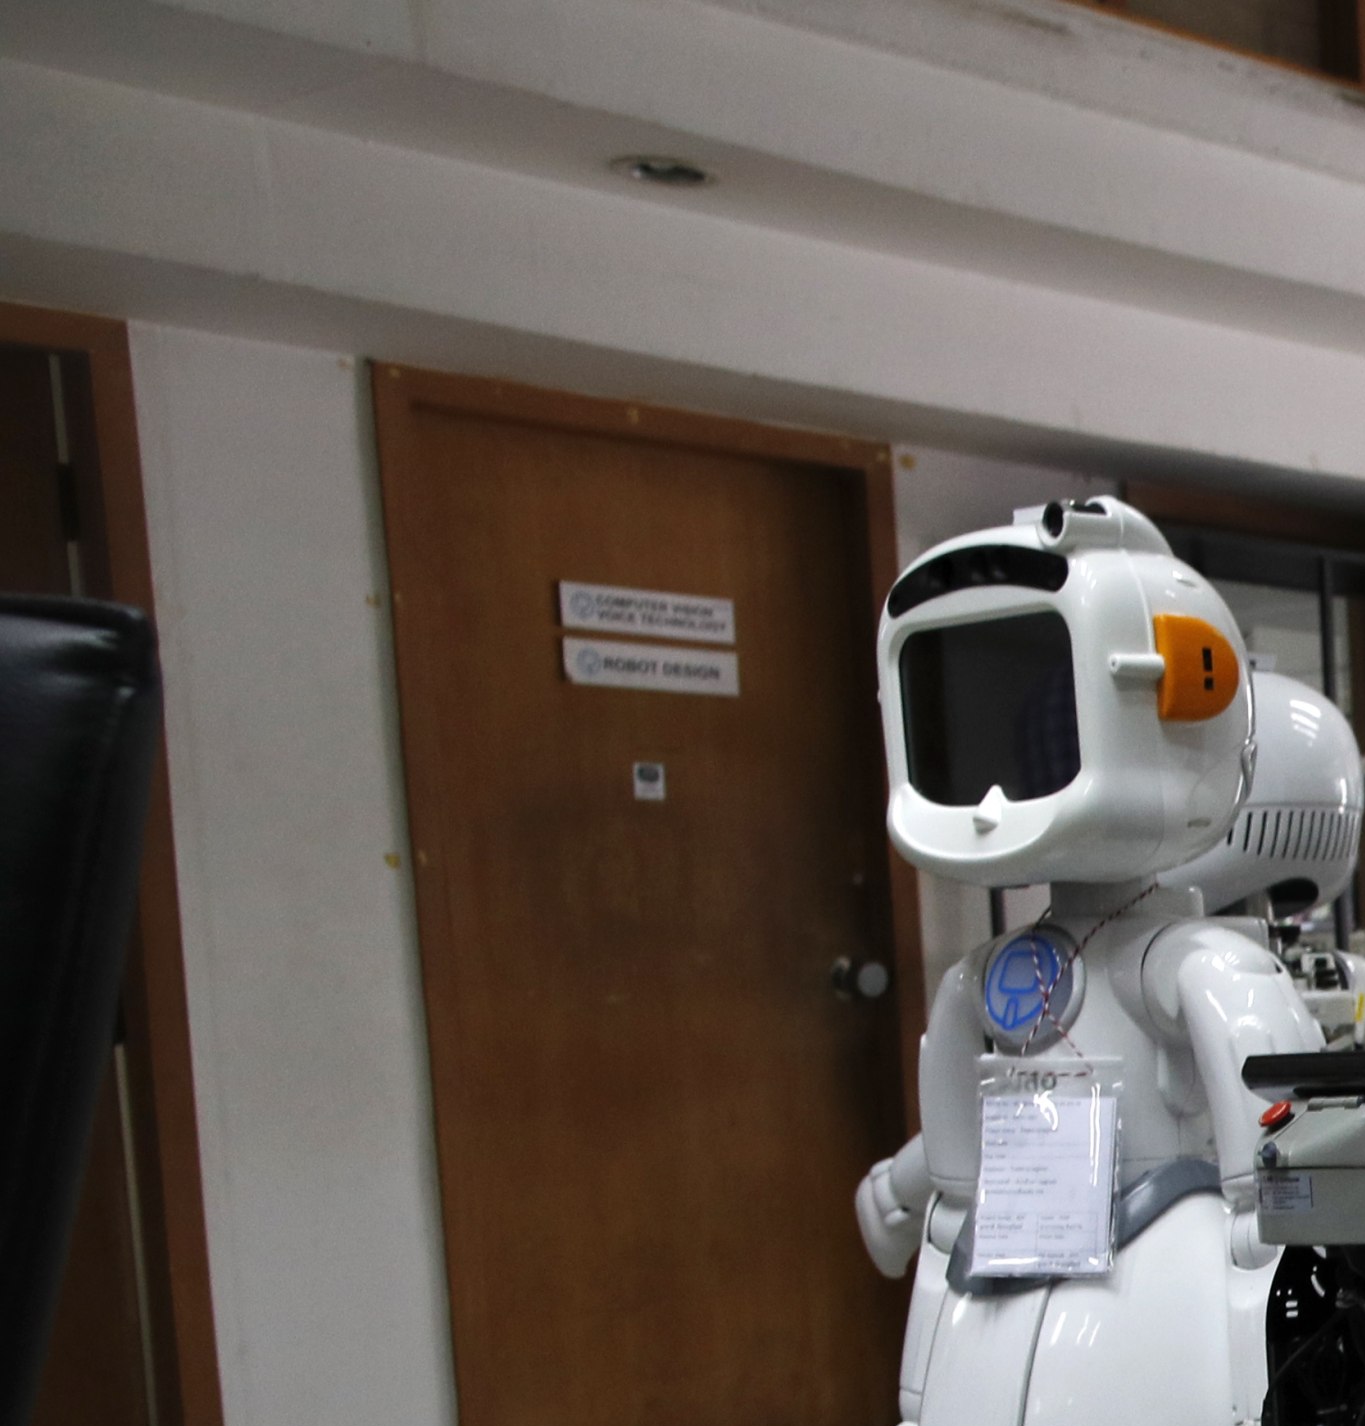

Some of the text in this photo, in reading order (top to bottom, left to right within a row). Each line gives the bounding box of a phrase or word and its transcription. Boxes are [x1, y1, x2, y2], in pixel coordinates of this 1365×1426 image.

[597, 594, 668, 611] COMPUTER
[641, 613, 726, 632] TECHNOLOGY
[603, 656, 720, 681] ROBOT DESIGN
